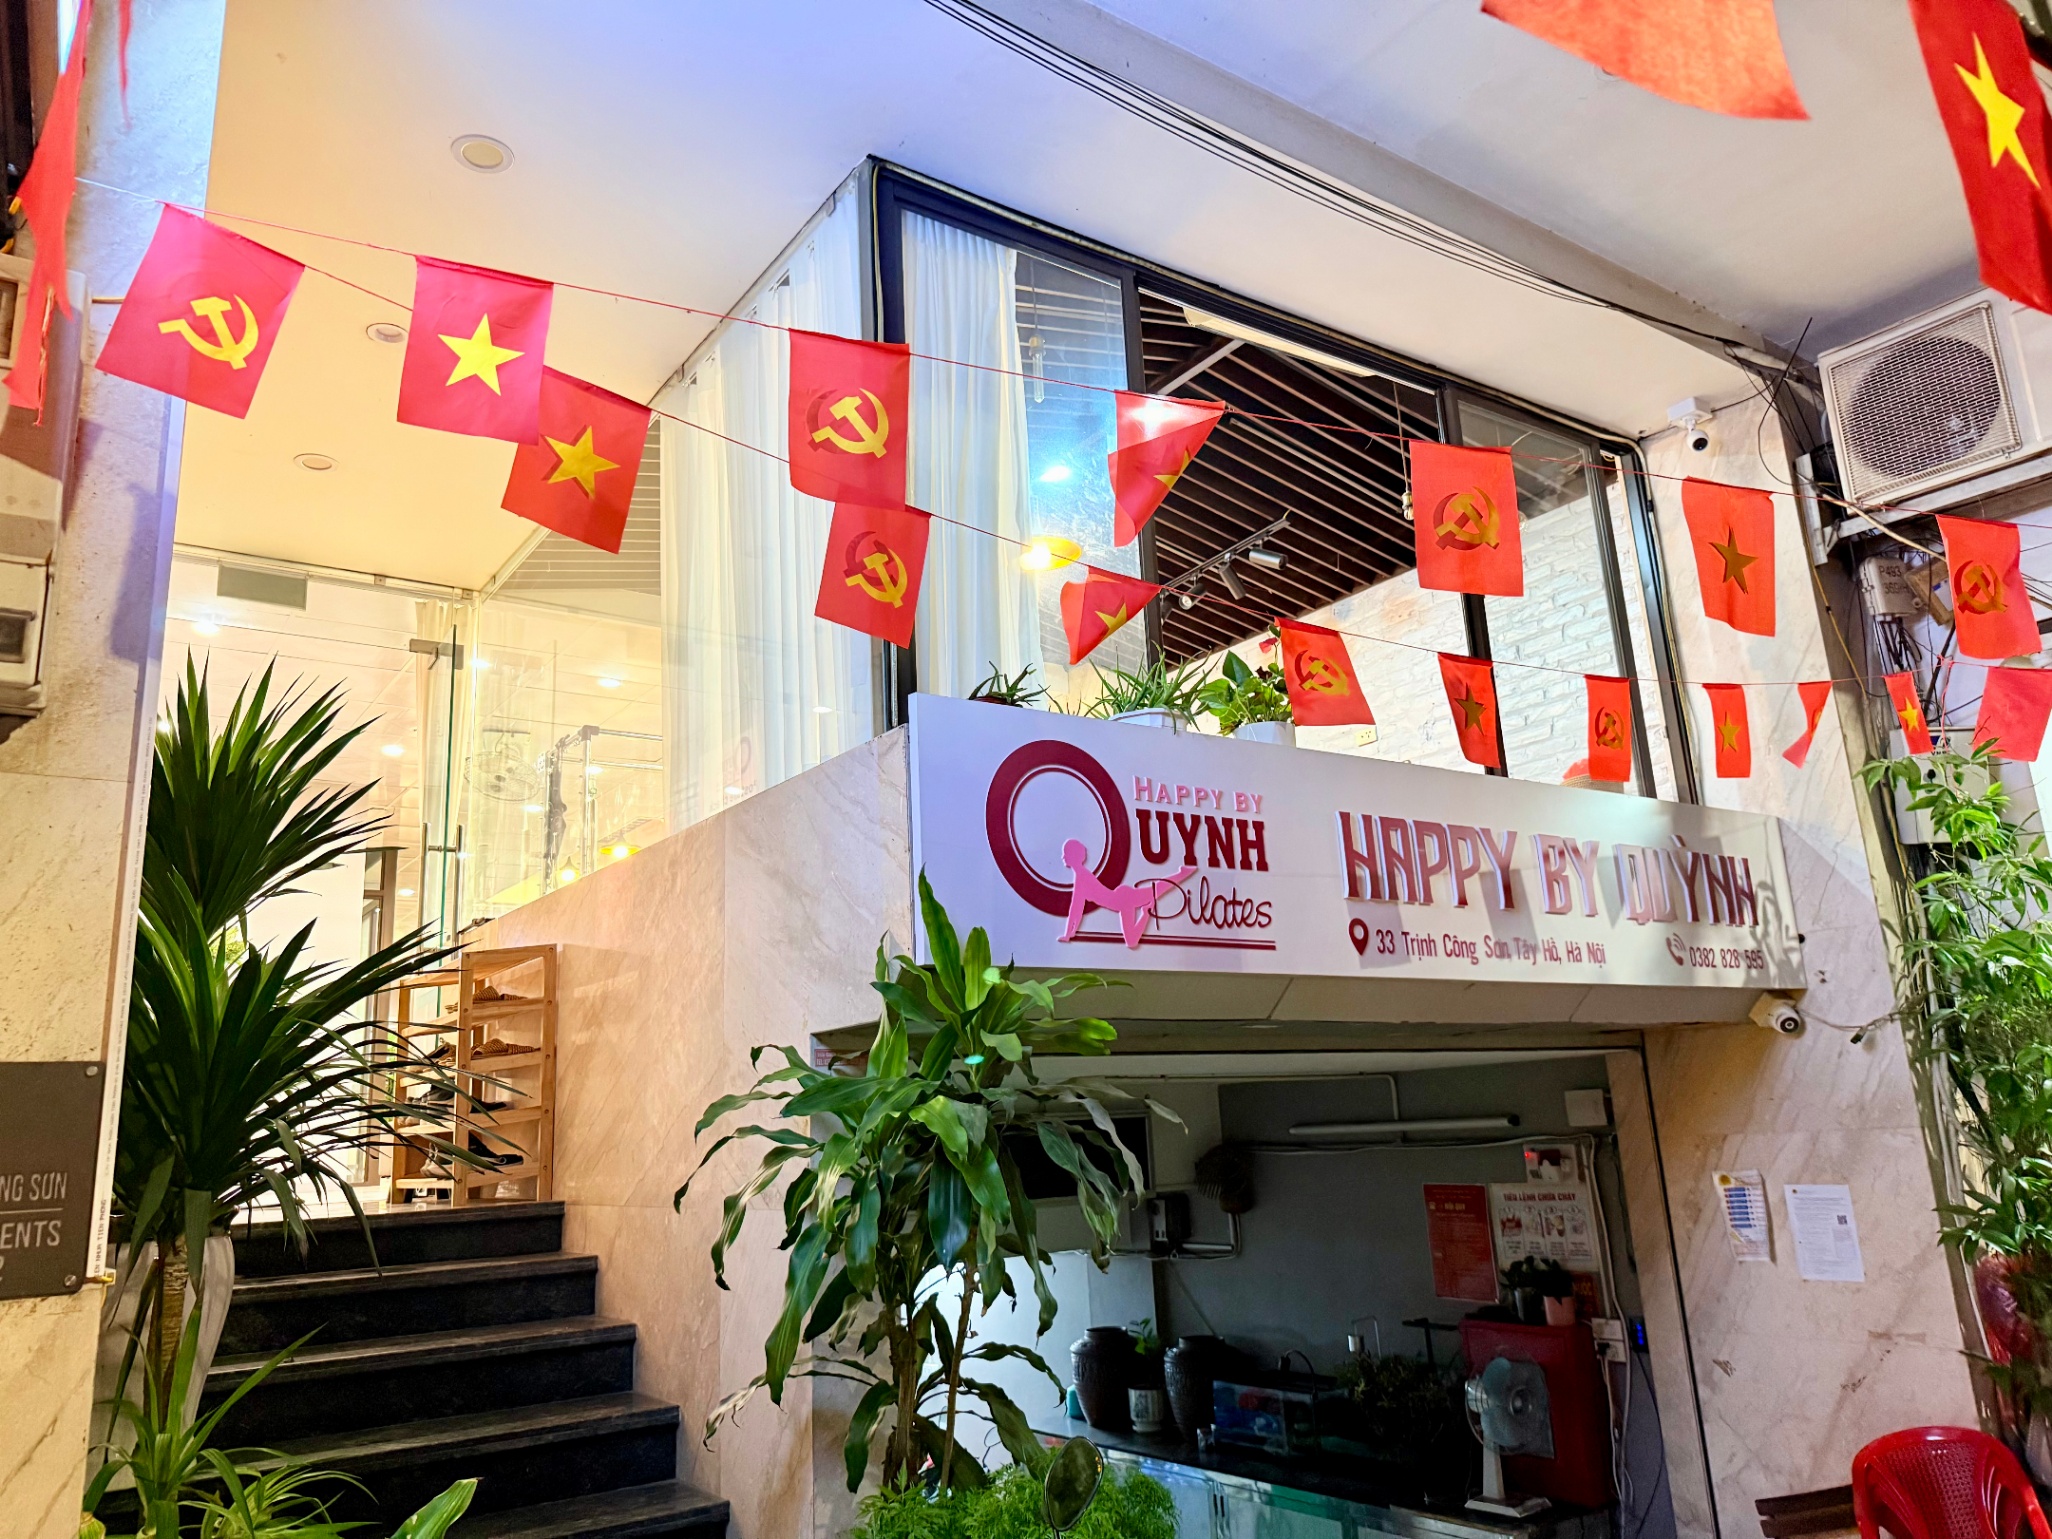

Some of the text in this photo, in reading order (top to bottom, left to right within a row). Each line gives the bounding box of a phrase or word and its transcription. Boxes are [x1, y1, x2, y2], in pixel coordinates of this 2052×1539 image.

[1133, 775, 1263, 814] HAPPY BY
[1335, 810, 1759, 928] HAPPY BY QUỲNH
[1134, 875, 1272, 931] Pilates
[1375, 928, 1395, 955] 33
[1401, 931, 1438, 961] Trịnh
[1442, 933, 1479, 966] Công
[1565, 940, 1583, 963] Hà
[1586, 941, 1606, 969] Nội
[1689, 946, 1764, 970] 0382 828 595
[0, 1220, 62, 1249] ENTS
